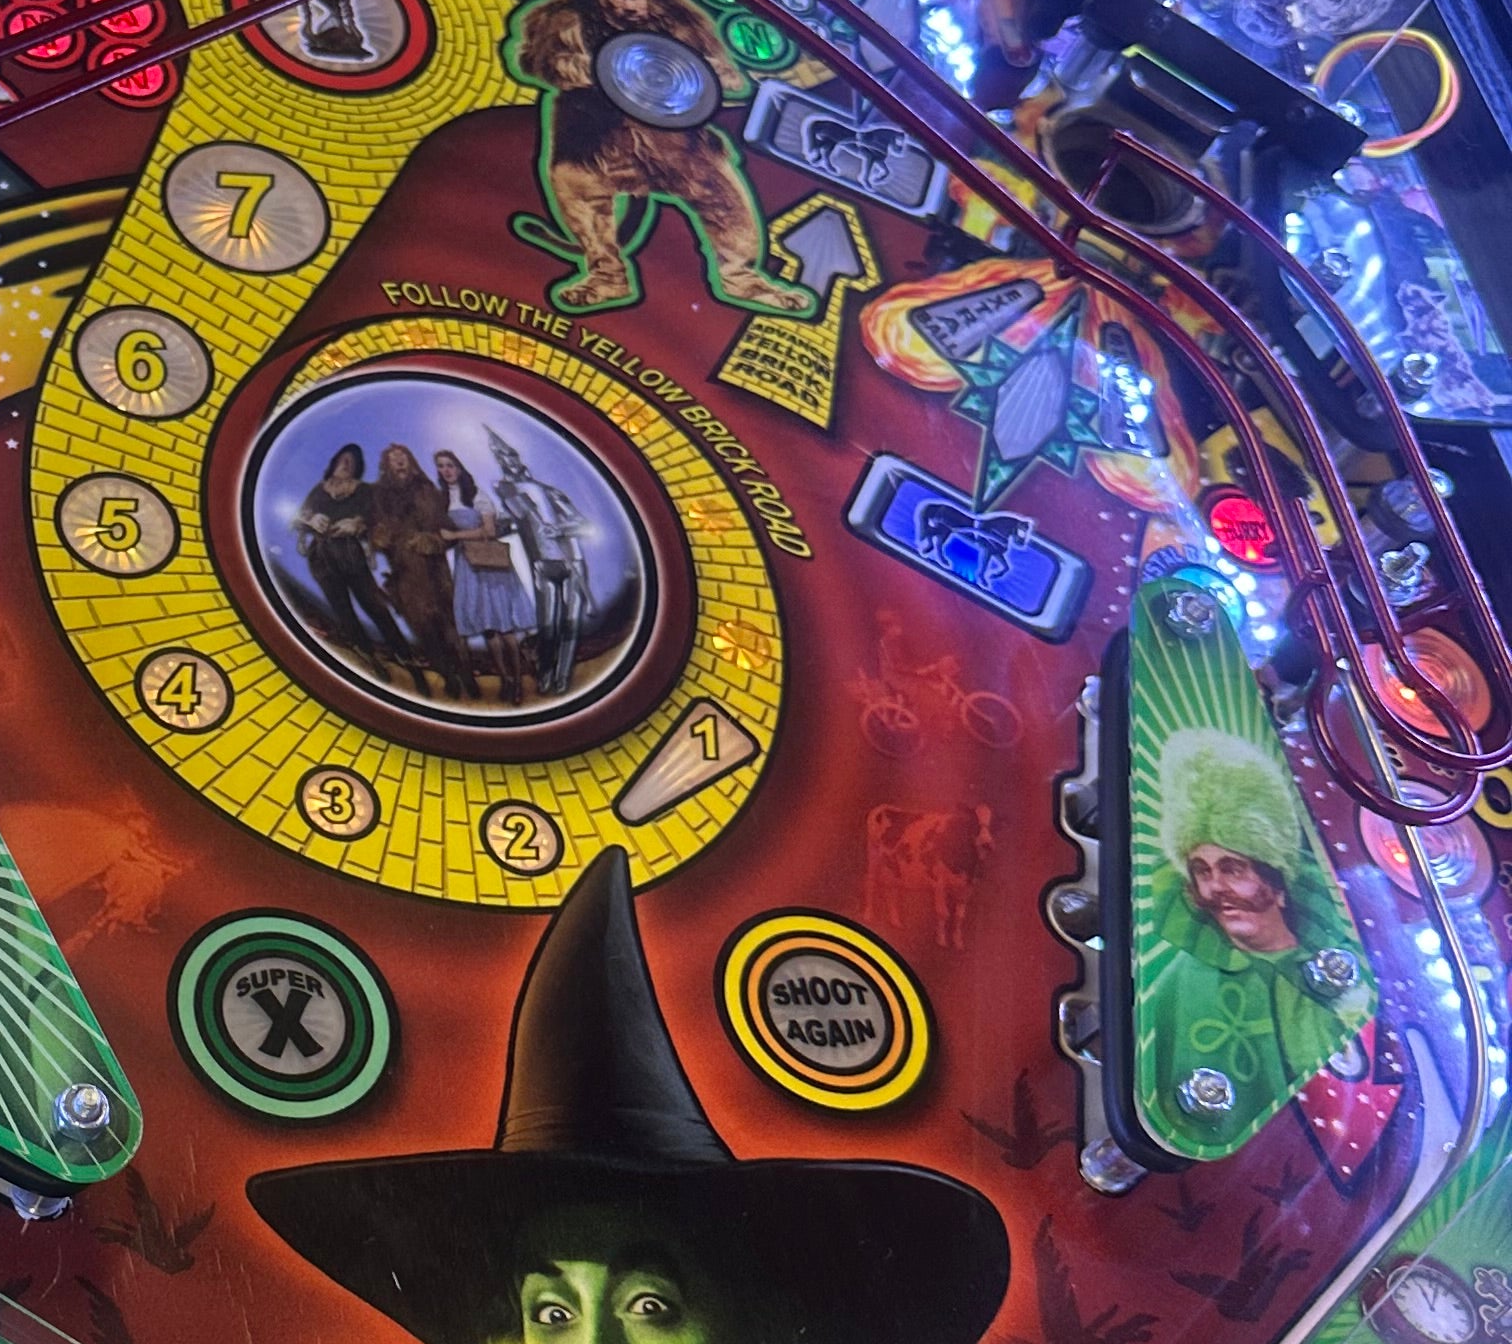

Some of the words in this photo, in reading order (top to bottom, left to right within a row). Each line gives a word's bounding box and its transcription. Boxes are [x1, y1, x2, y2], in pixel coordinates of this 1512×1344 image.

[215, 170, 276, 240] 7
[940, 287, 1023, 334] EXTRA
[113, 328, 169, 395] 6
[744, 333, 831, 382] YELLOW
[751, 323, 831, 366] ADVANCE
[732, 361, 821, 408] ROAD
[740, 348, 825, 395] BRICK
[381, 281, 508, 317] FOLLOW
[516, 302, 573, 338] THE
[578, 328, 695, 404] YELLOW
[677, 399, 764, 478] BRICK
[740, 476, 814, 560] ROAD
[96, 496, 142, 554] 5
[158, 661, 204, 716] 4
[688, 713, 720, 762] 1
[317, 777, 356, 826] 3
[501, 812, 542, 863] 2
[234, 967, 328, 1002] SUPER
[771, 975, 870, 1011] SHOOT
[250, 987, 326, 1058] X
[785, 1016, 877, 1050] AGAIN
